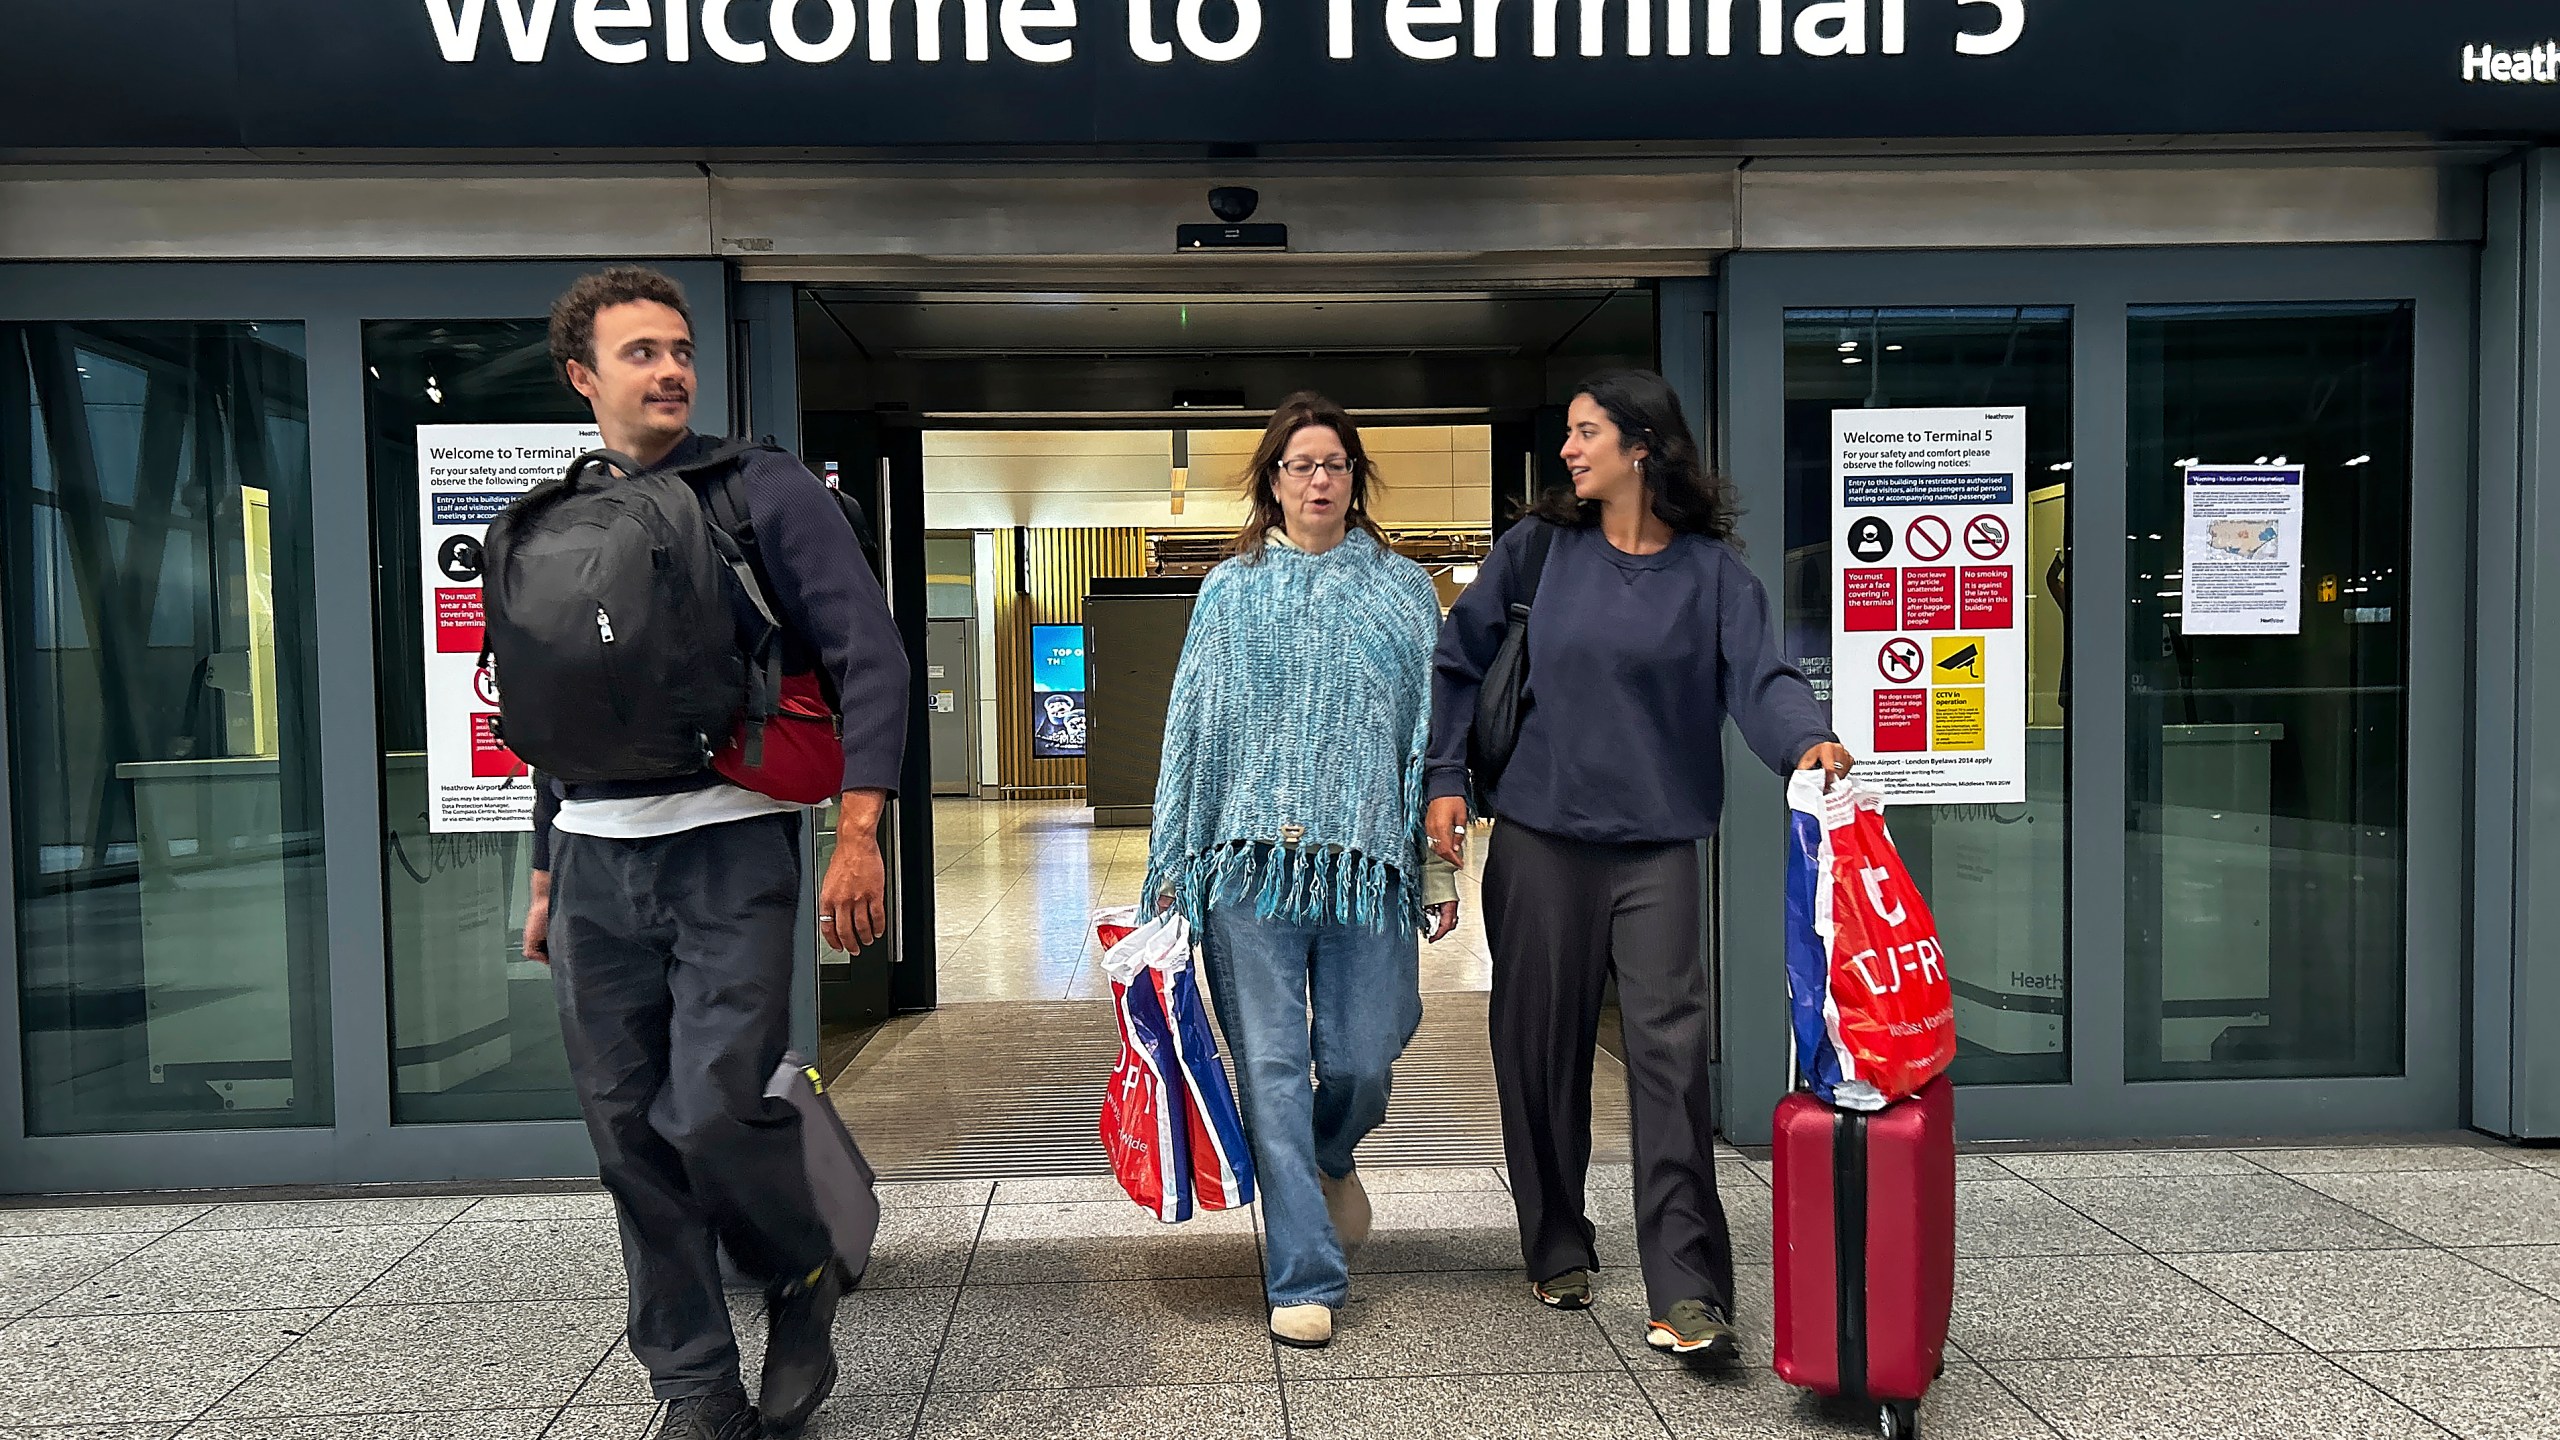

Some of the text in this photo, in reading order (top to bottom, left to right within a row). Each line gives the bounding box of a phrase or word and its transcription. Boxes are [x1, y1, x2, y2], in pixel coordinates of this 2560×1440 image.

[424, 0, 2025, 63] Welcome to Terminal 5
[2461, 40, 2560, 82] Heath
[1843, 429, 1992, 444] Welcome to Terminal 5
[430, 447, 494, 459] Welcome
[497, 448, 512, 459] to
[514, 446, 578, 459] Terminal
[1843, 448, 1991, 461] For your safety and comfort please
[1843, 458, 1971, 470] observe the following notices:
[430, 467, 445, 476] For
[446, 468, 468, 477] your
[469, 466, 497, 476] safety
[498, 466, 517, 475] and
[518, 466, 555, 475] comfort
[430, 477, 466, 486] observe
[468, 477, 483, 486] the
[485, 476, 529, 486] following
[1848, 479, 1867, 488] Entry
[1888, 478, 1918, 487] building
[1925, 477, 1957, 485] restricted
[1966, 476, 2003, 484] authorised
[1878, 486, 1905, 494] visitors,
[1927, 486, 1965, 494] passengers
[1980, 485, 2007, 493] persons
[436, 496, 456, 505] Entry
[479, 496, 510, 505] building
[1848, 495, 1876, 503] meeting
[1885, 494, 1934, 502] accompanying
[1958, 493, 1996, 501] passengers
[469, 504, 497, 512] visitors,
[437, 512, 466, 521] meeting
[1848, 573, 1863, 581] You
[1976, 570, 2008, 579] smoking
[1875, 581, 1891, 589] face
[1907, 585, 1944, 593] unattended
[1977, 581, 2002, 590] against
[1848, 590, 1880, 599] covering
[1848, 598, 1894, 607] the terminal
[1964, 604, 1992, 612] building
[440, 610, 484, 619] covering in
[454, 619, 486, 627] termina
[1907, 618, 1929, 626] people
[1053, 648, 1084, 657] TOP O
[1936, 691, 1953, 699] CCTV
[1935, 698, 1967, 706] operation
[2011, 970, 2064, 991] Heath
